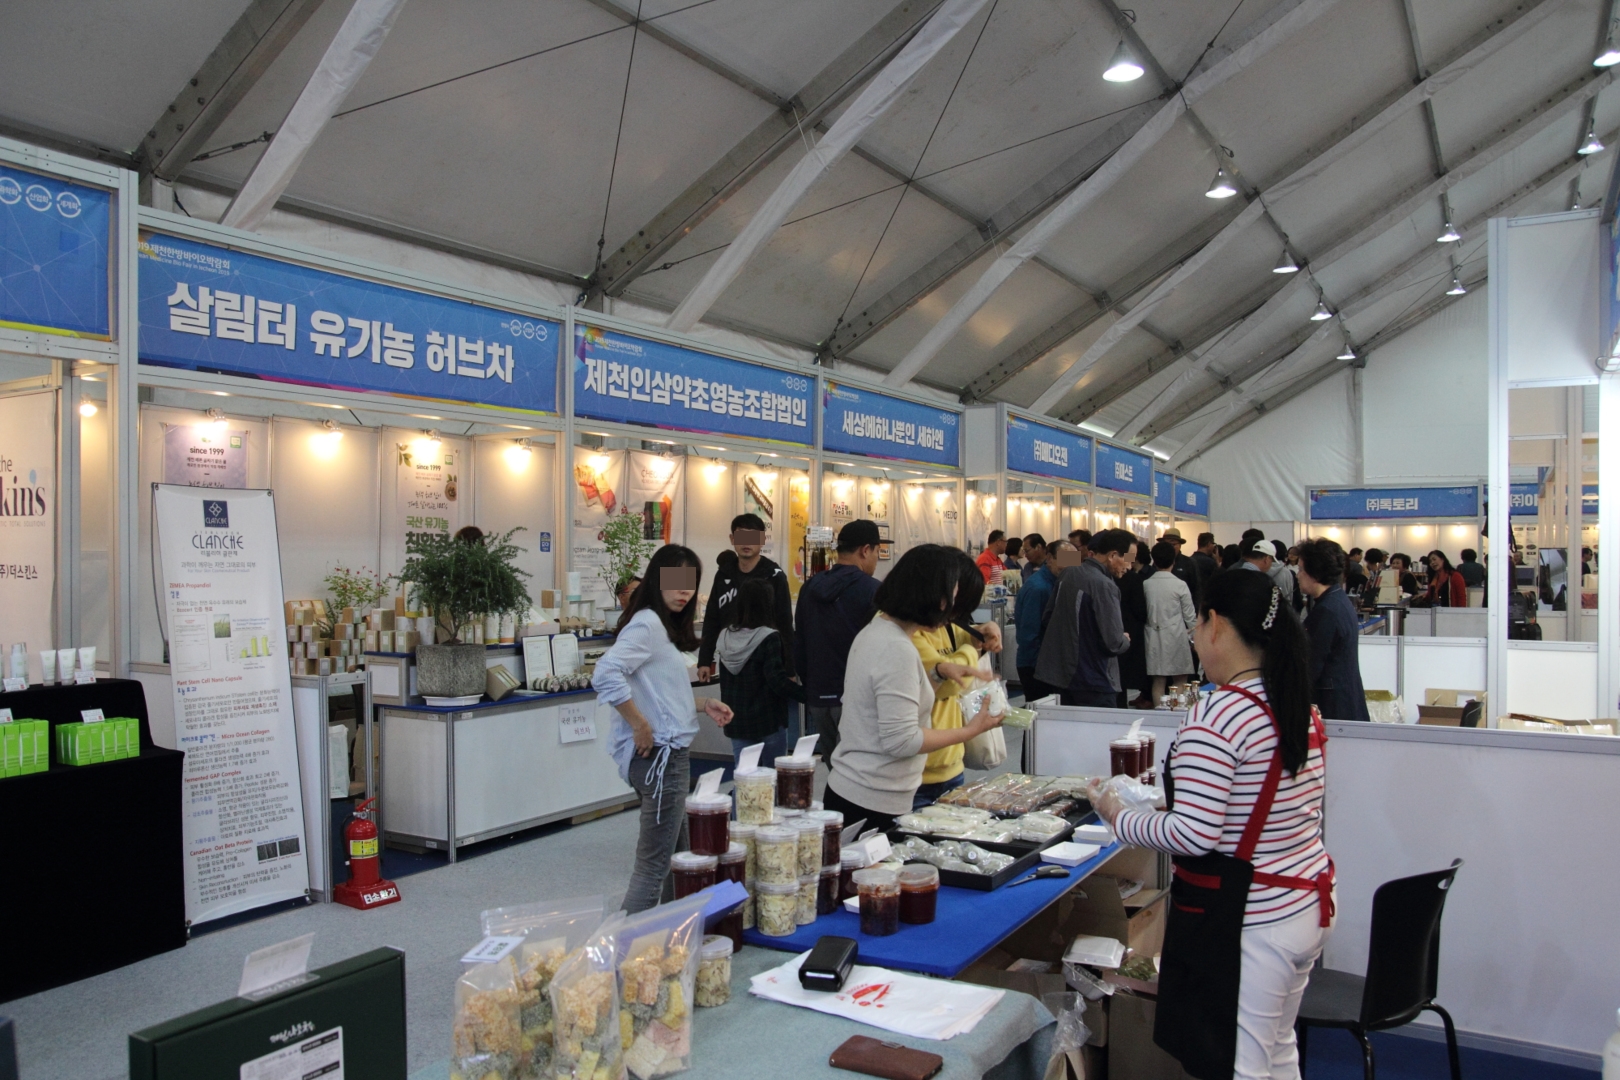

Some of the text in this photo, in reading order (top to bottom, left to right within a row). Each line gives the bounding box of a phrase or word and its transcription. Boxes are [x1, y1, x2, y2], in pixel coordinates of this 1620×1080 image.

[168, 282, 514, 384] 살림터 유기농 허브차
[584, 358, 807, 427] 제천인삼약초영농조합법인
[842, 410, 915, 446] 세상에하나뿐인
[190, 446, 207, 454] since
[406, 516, 449, 530] 국산 유기농
[192, 535, 244, 549] CLANCHE
